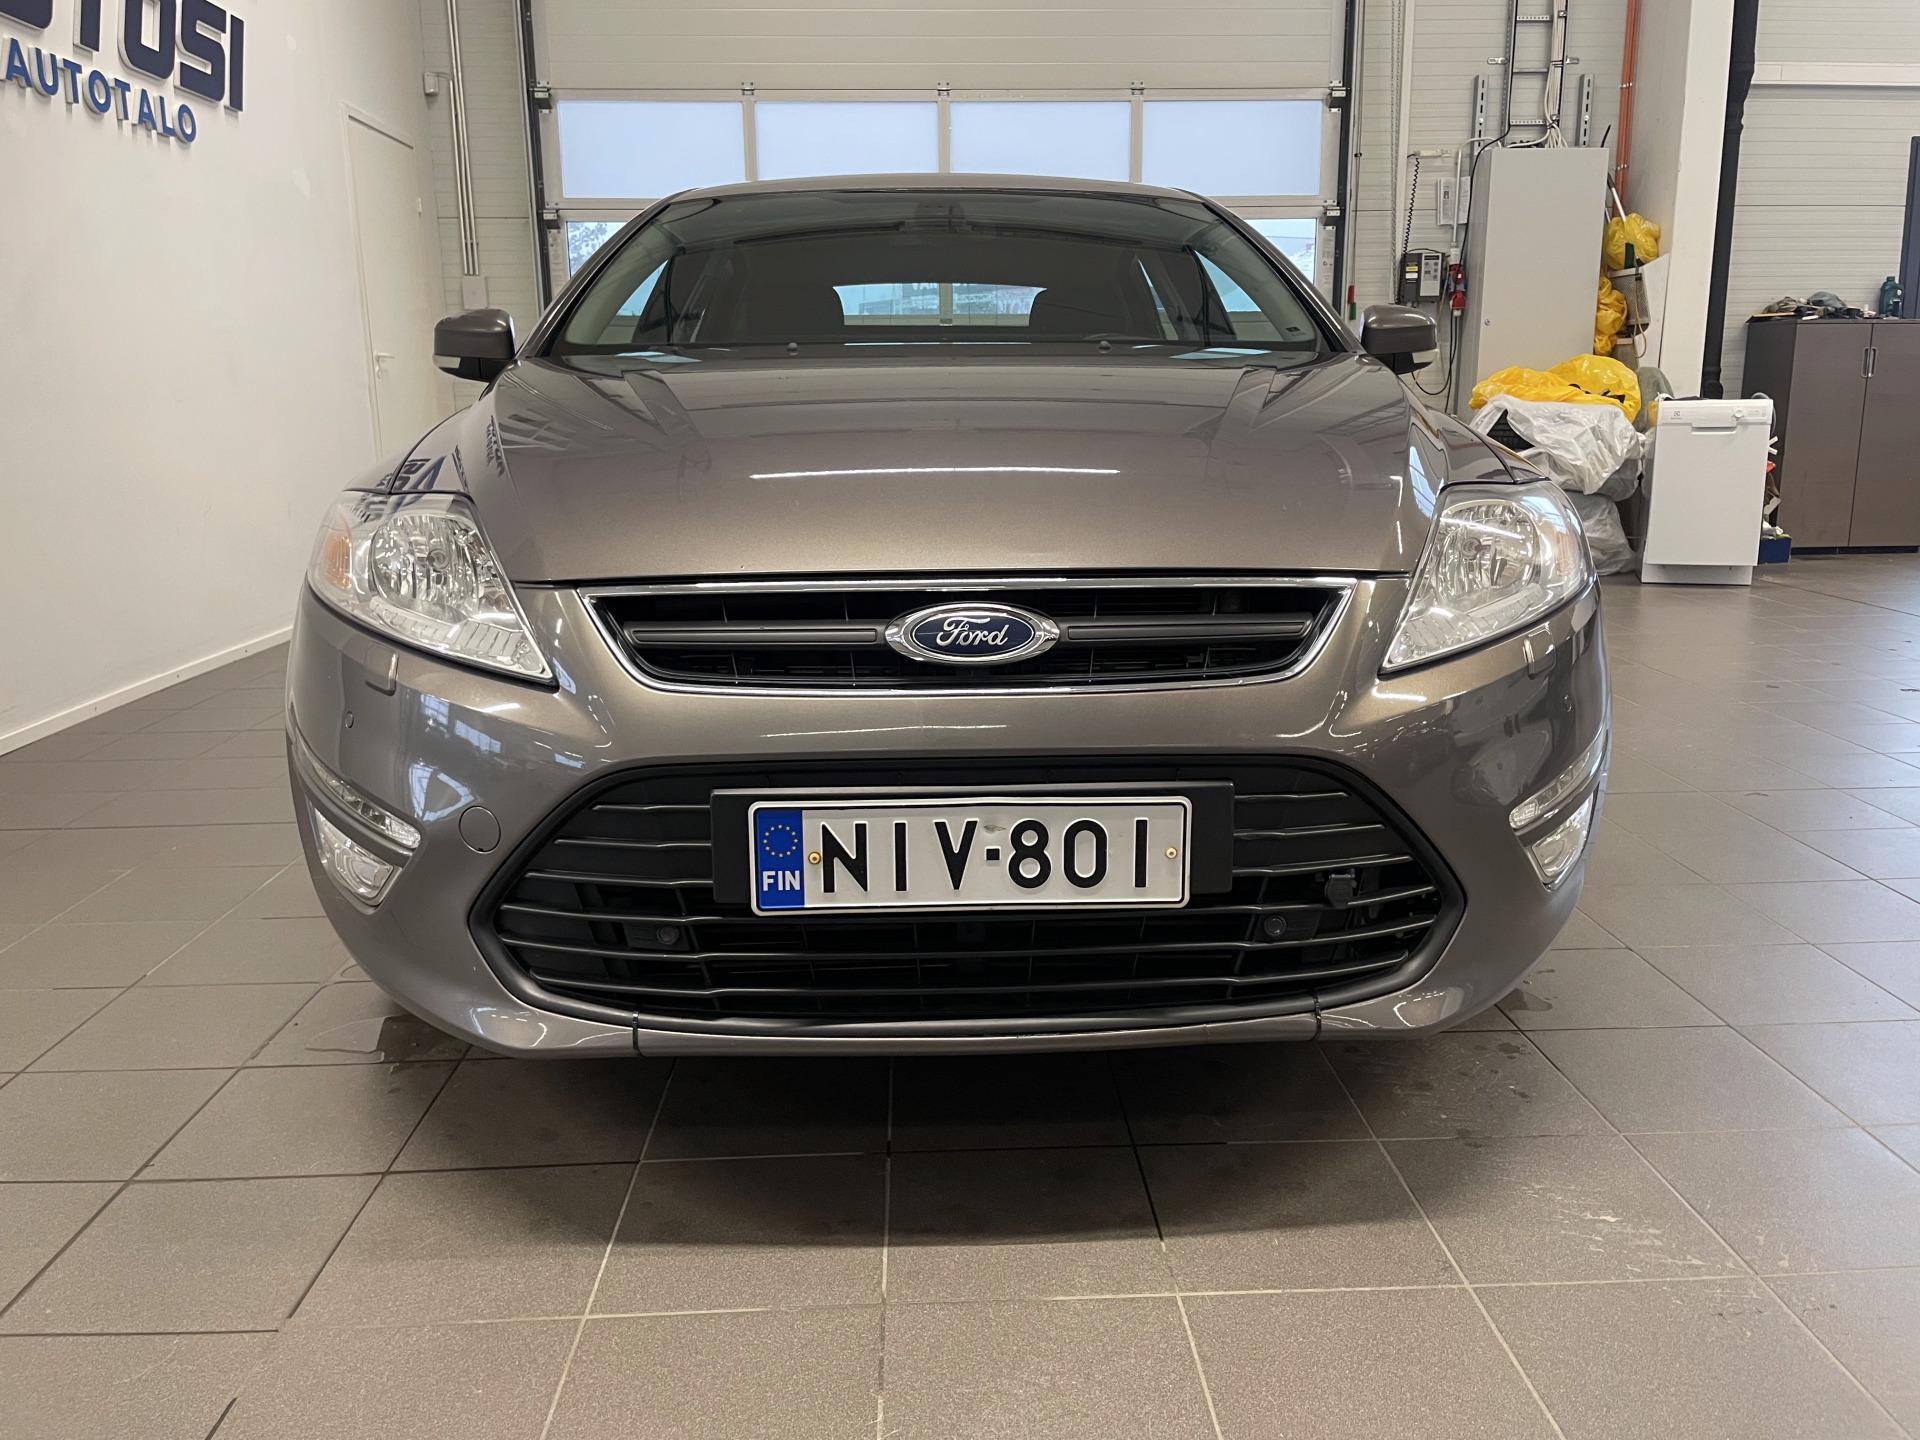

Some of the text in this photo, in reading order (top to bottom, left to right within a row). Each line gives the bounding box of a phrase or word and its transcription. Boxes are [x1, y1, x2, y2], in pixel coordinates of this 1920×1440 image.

[4, 37, 197, 143] AUTOTALO
[936, 616, 1010, 647] Ford
[762, 870, 801, 892] FIN
[820, 818, 1149, 894] NIV-801
